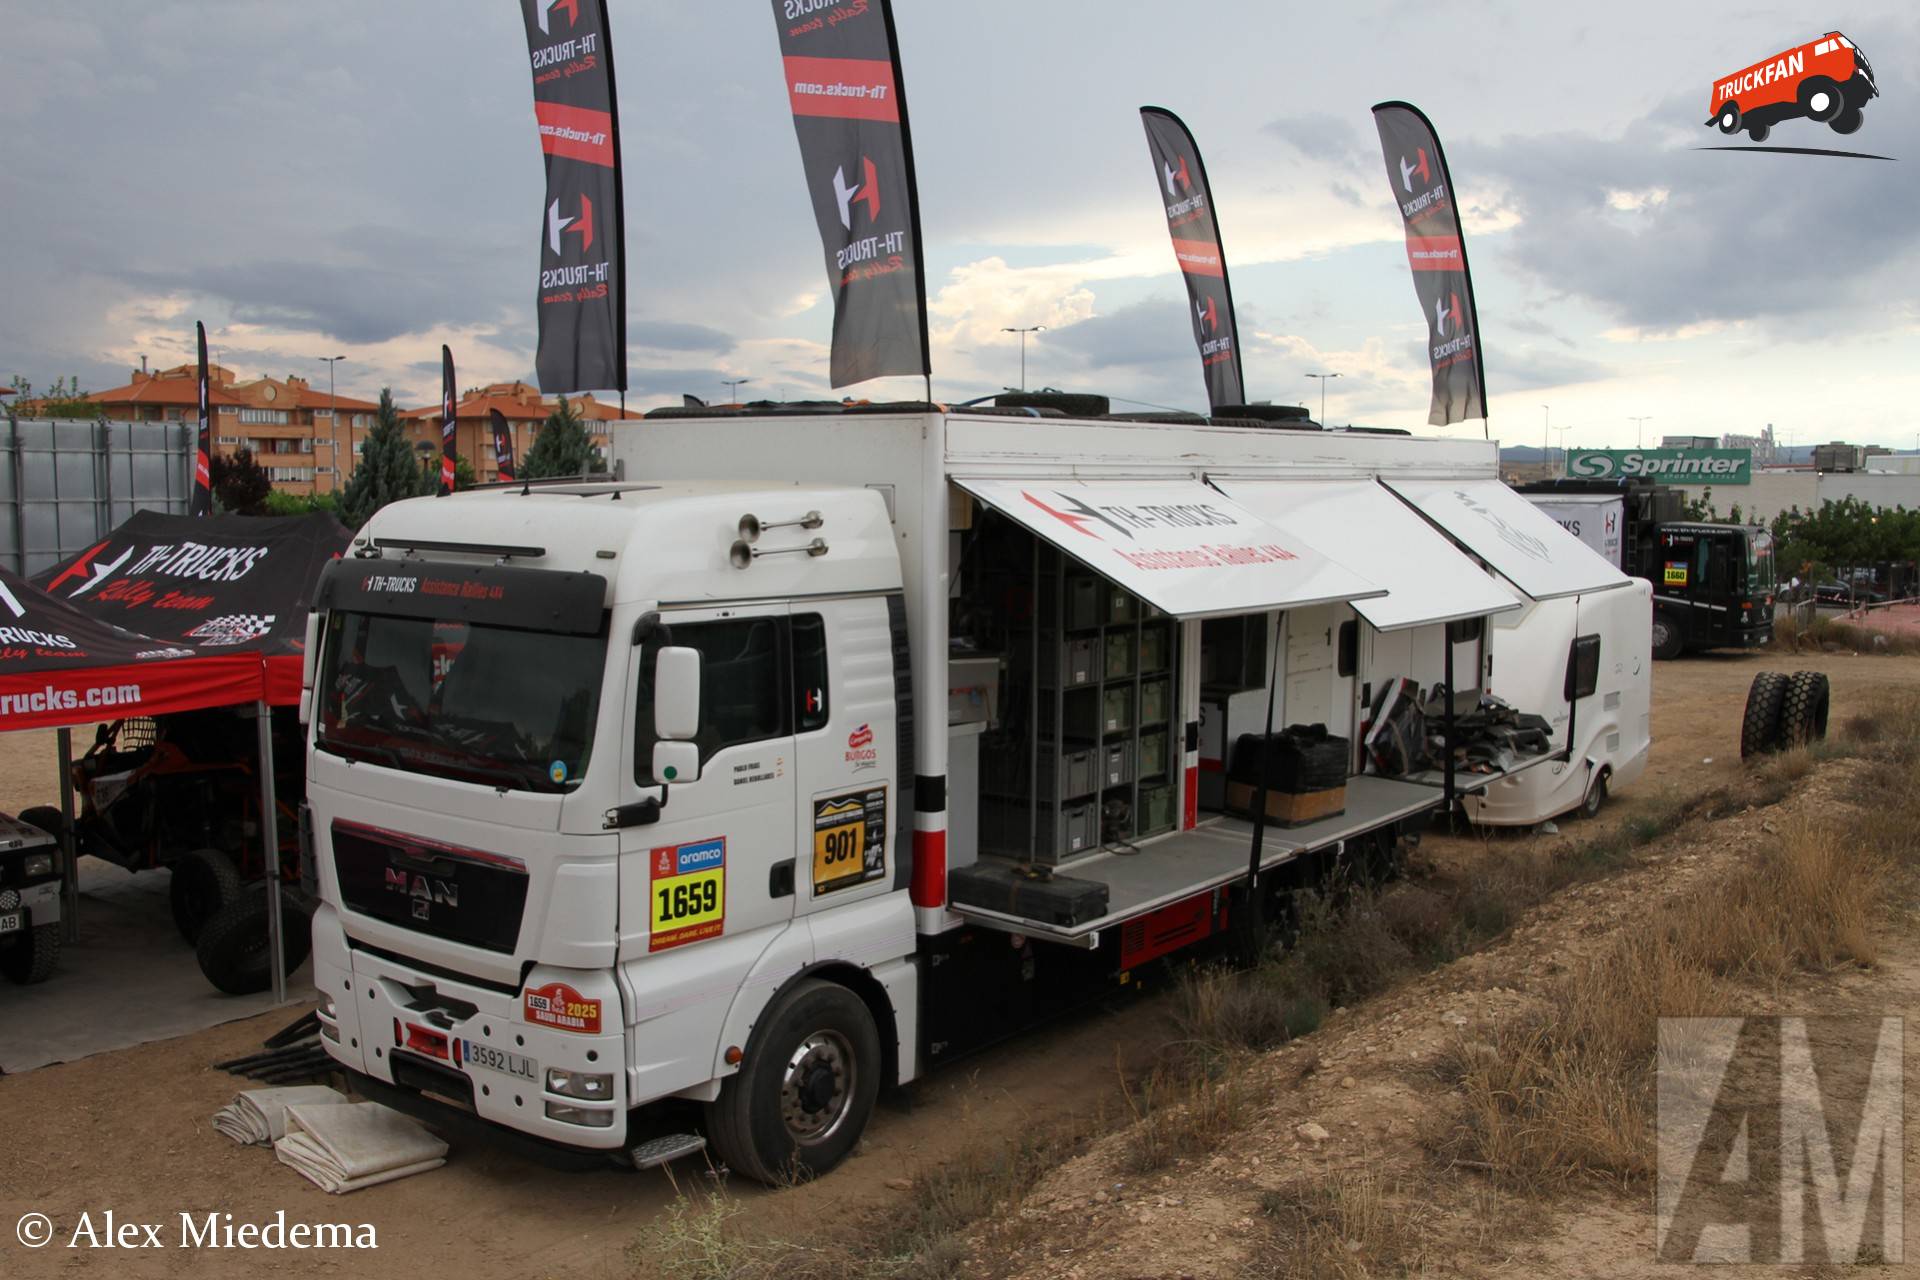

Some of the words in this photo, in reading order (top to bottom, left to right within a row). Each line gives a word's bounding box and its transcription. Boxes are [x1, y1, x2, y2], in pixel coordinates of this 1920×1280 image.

[1620, 452, 1746, 476] Sprinter
[1099, 504, 1238, 528] TH-TRUCKS
[125, 541, 268, 581] TH-TRUCKS
[91, 578, 156, 609] Rally
[373, 576, 417, 593] TH-TRUCKS
[35, 647, 88, 657] team
[0, 684, 142, 715] rucks.com
[680, 848, 721, 864] aramco
[824, 828, 857, 865] 901
[385, 867, 459, 907] MAN
[658, 879, 717, 922] 1659
[1, 916, 17, 930] AB
[530, 996, 547, 1009] 1659
[567, 1003, 597, 1018] 2025
[535, 1010, 556, 1023] SAUDI
[557, 1015, 585, 1029] ARABIA
[472, 1045, 505, 1070] 3592
[509, 1056, 535, 1078] LJL
